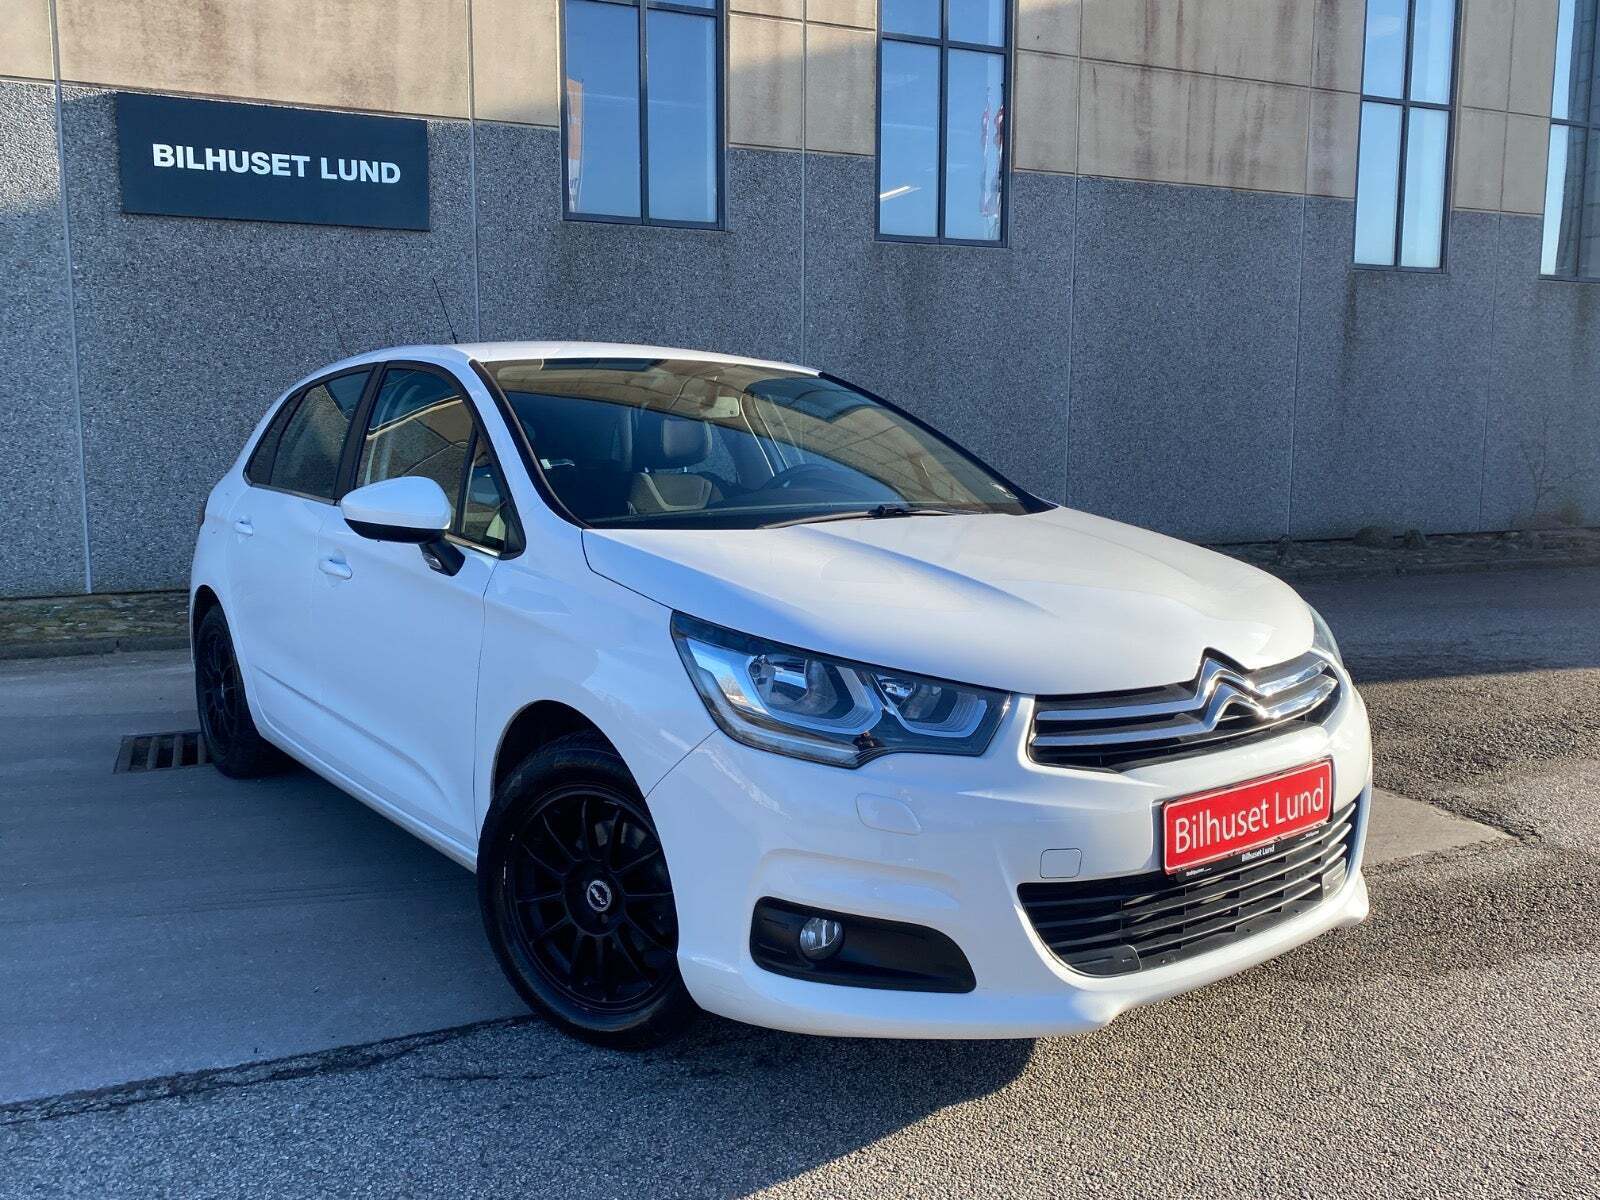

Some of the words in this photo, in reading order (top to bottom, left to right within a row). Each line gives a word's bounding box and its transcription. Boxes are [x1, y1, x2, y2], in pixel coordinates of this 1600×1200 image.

[152, 143, 310, 178] BILHUSET
[320, 157, 401, 184] LUND
[1175, 797, 1270, 854] Bilhuset
[1275, 776, 1324, 825] Lund
